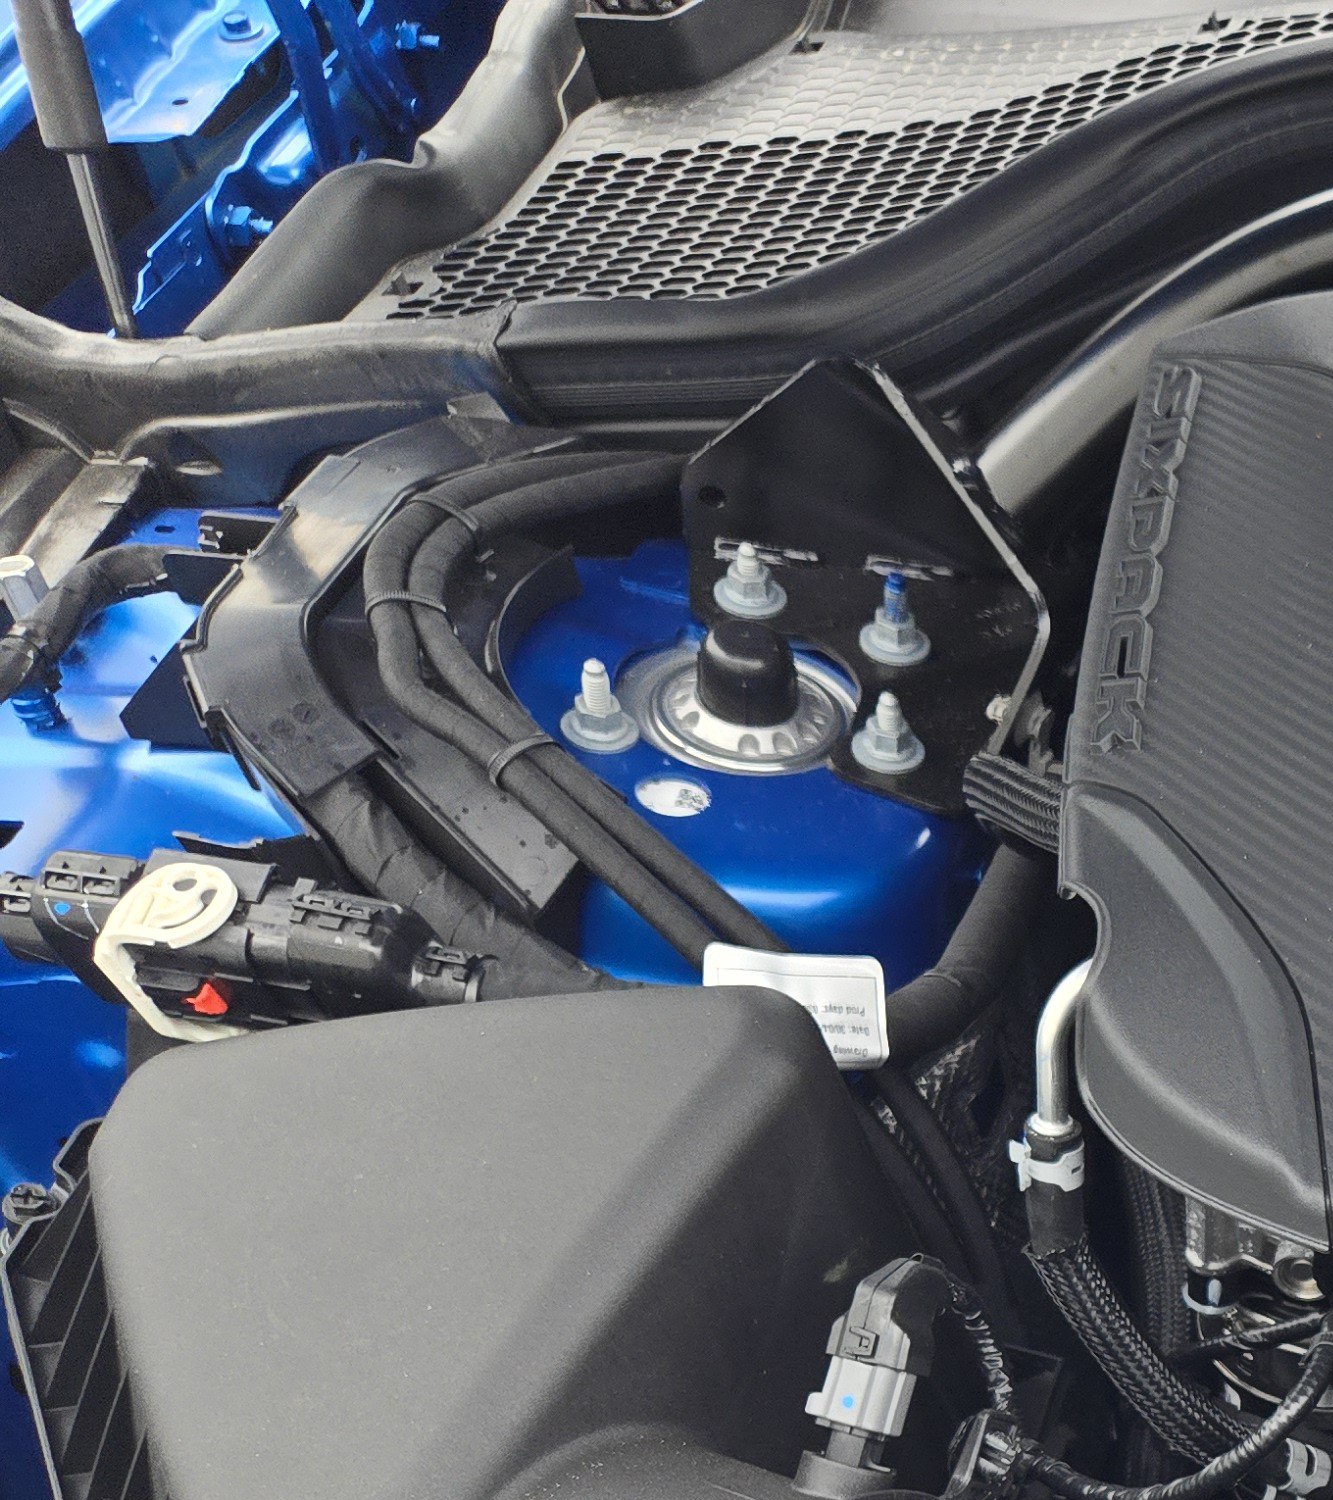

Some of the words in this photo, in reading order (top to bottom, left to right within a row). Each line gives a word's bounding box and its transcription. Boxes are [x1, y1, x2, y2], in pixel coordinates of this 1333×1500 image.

[1090, 365, 1203, 755] SIXPACK
[845, 1005, 866, 1017] Prod
[832, 1044, 869, 1058] Drawing
